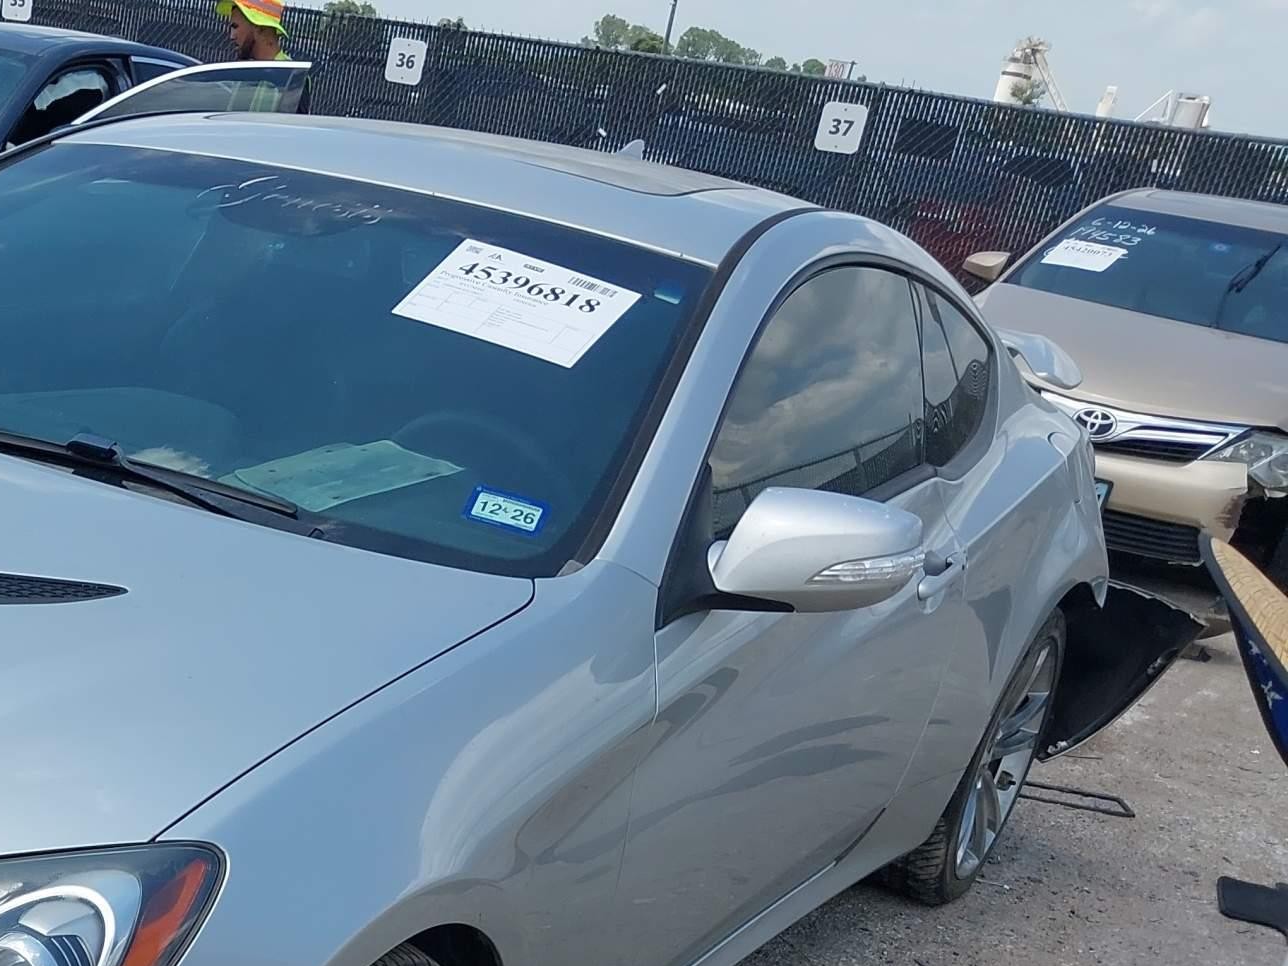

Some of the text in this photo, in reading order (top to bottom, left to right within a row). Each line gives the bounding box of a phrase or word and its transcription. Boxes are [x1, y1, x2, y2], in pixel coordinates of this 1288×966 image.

[395, 53, 416, 69] 36
[828, 118, 855, 137] 37
[458, 262, 601, 314] 45396818
[480, 501, 503, 516] 12
[510, 509, 536, 525] 26
